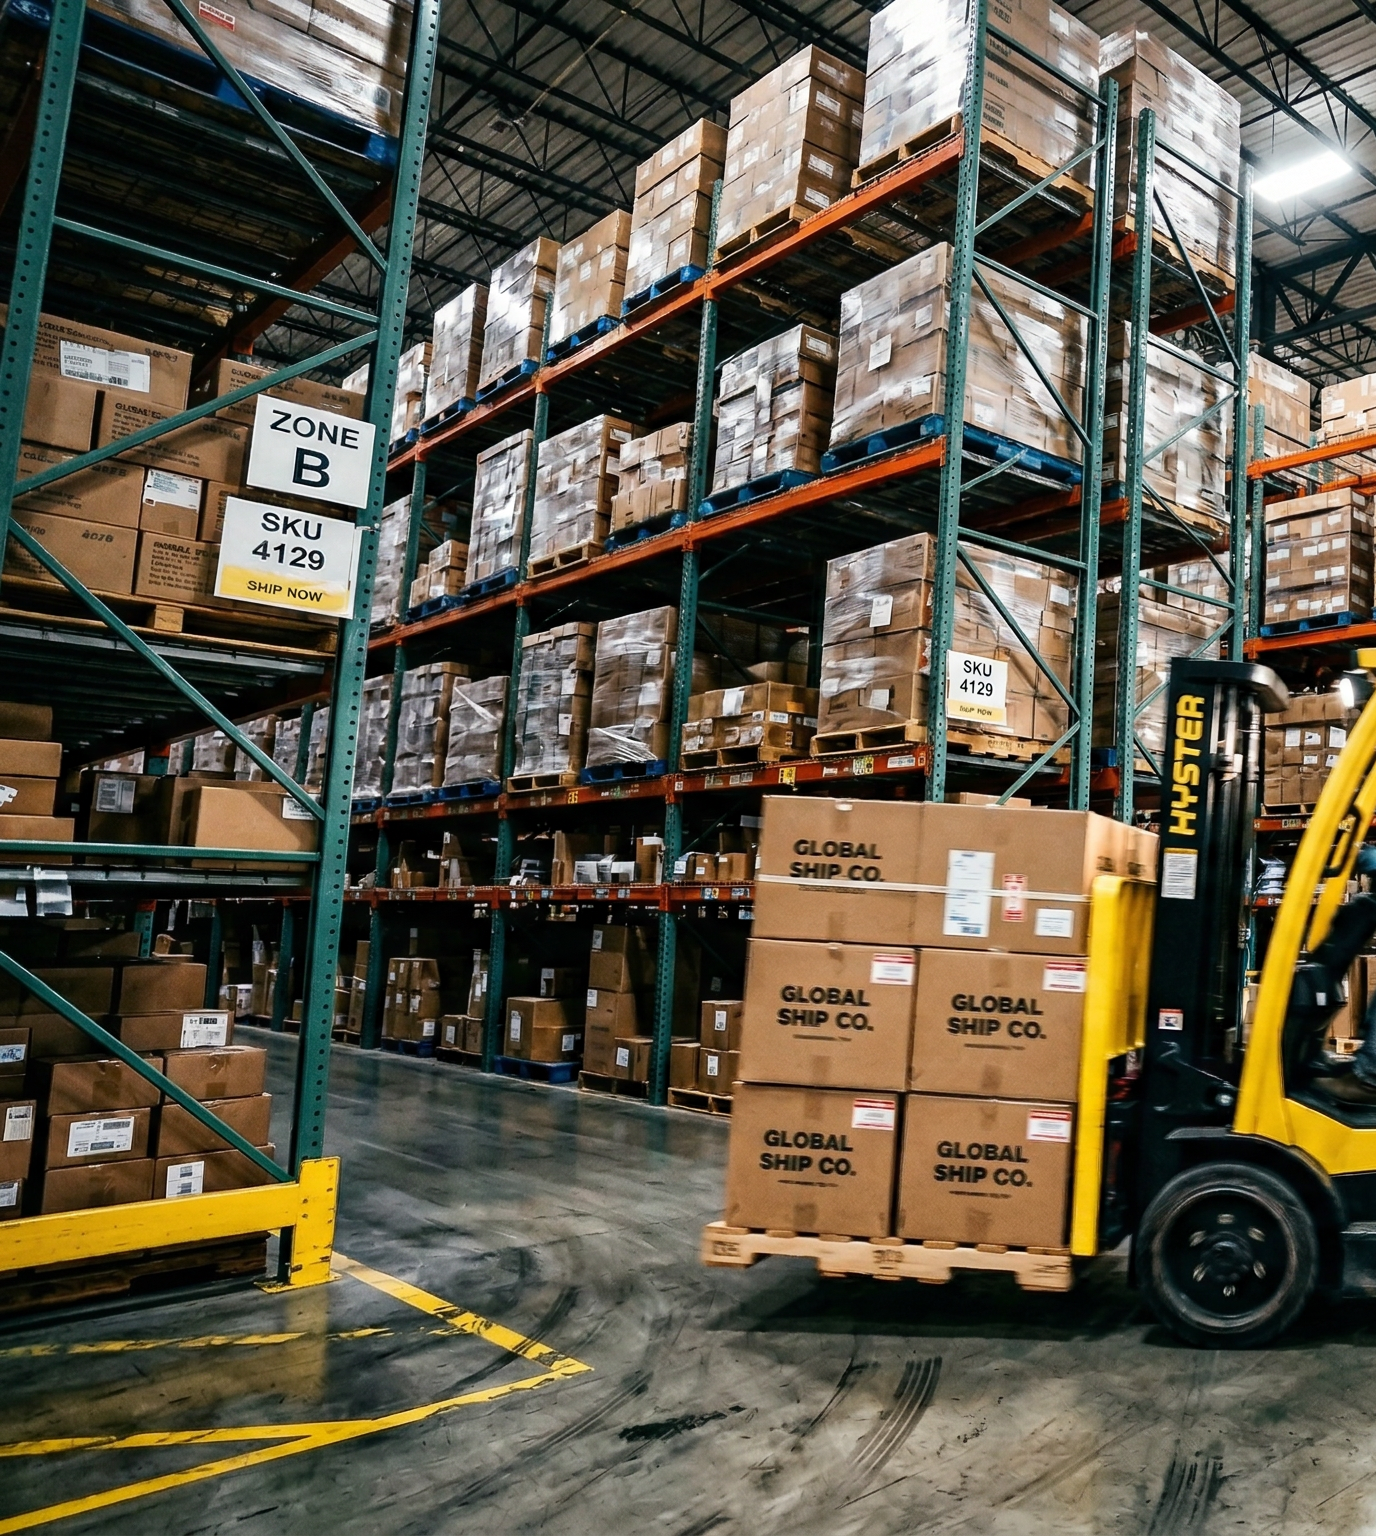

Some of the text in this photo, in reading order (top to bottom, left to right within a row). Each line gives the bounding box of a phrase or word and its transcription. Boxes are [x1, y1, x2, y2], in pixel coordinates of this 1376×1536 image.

[270, 409, 360, 450] ZONE
[292, 447, 330, 488] B
[261, 512, 322, 540] SKU
[252, 540, 325, 571] 4129
[247, 580, 323, 602] SHIP NOW
[963, 660, 992, 677] SKU
[960, 679, 993, 697] 4129
[1168, 694, 1205, 836] HYSTER
[793, 839, 883, 859] GLOBAL
[790, 861, 886, 882] SHIP CO.
[780, 985, 871, 1007] GLOBAL
[951, 993, 1044, 1015] GLOBAL
[776, 1008, 874, 1032] SHIP CO.
[947, 1016, 1047, 1039] SHIP CO.
[763, 1129, 853, 1152] GLOBAL
[937, 1140, 1029, 1163] GLOBAL
[759, 1152, 857, 1177] SHIP CO.
[933, 1164, 1033, 1187] SHIP CO.
